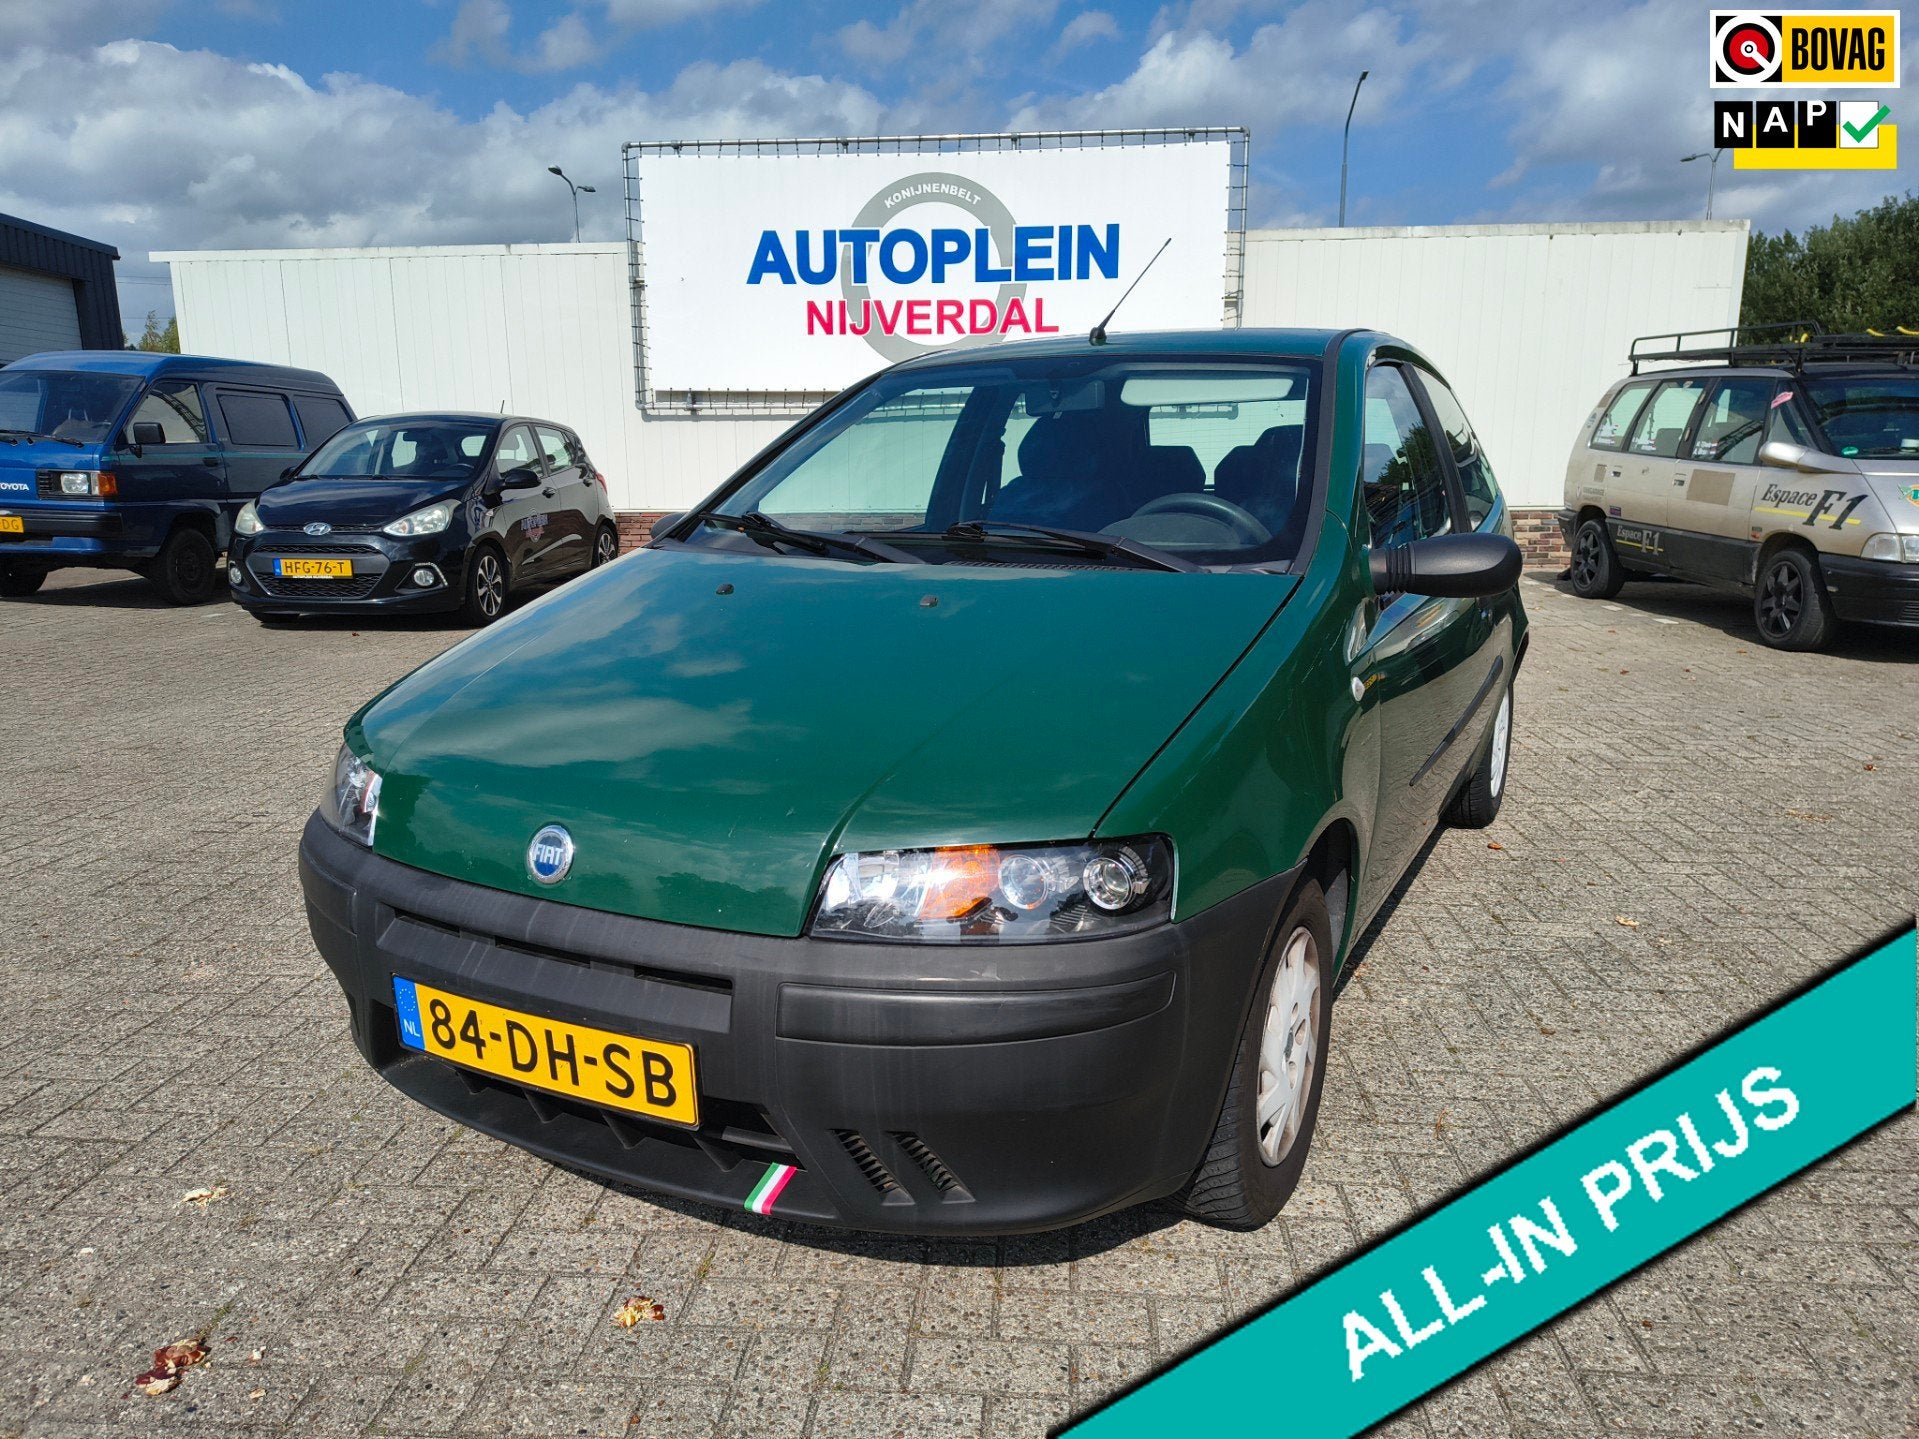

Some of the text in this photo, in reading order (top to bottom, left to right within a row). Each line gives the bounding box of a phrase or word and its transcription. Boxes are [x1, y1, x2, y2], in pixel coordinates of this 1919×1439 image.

[884, 183, 981, 208] KONIJNENBELT
[747, 223, 1120, 286] AUTOPLEIN
[806, 297, 1059, 337] NIJVERDAL
[1761, 484, 1869, 530] Espace F1
[1617, 525, 1660, 556] Espace F1
[284, 562, 344, 574] HFG-76-T
[534, 843, 564, 866] FIAT
[404, 1018, 421, 1038] NL
[429, 998, 677, 1107] 84-DH-SB
